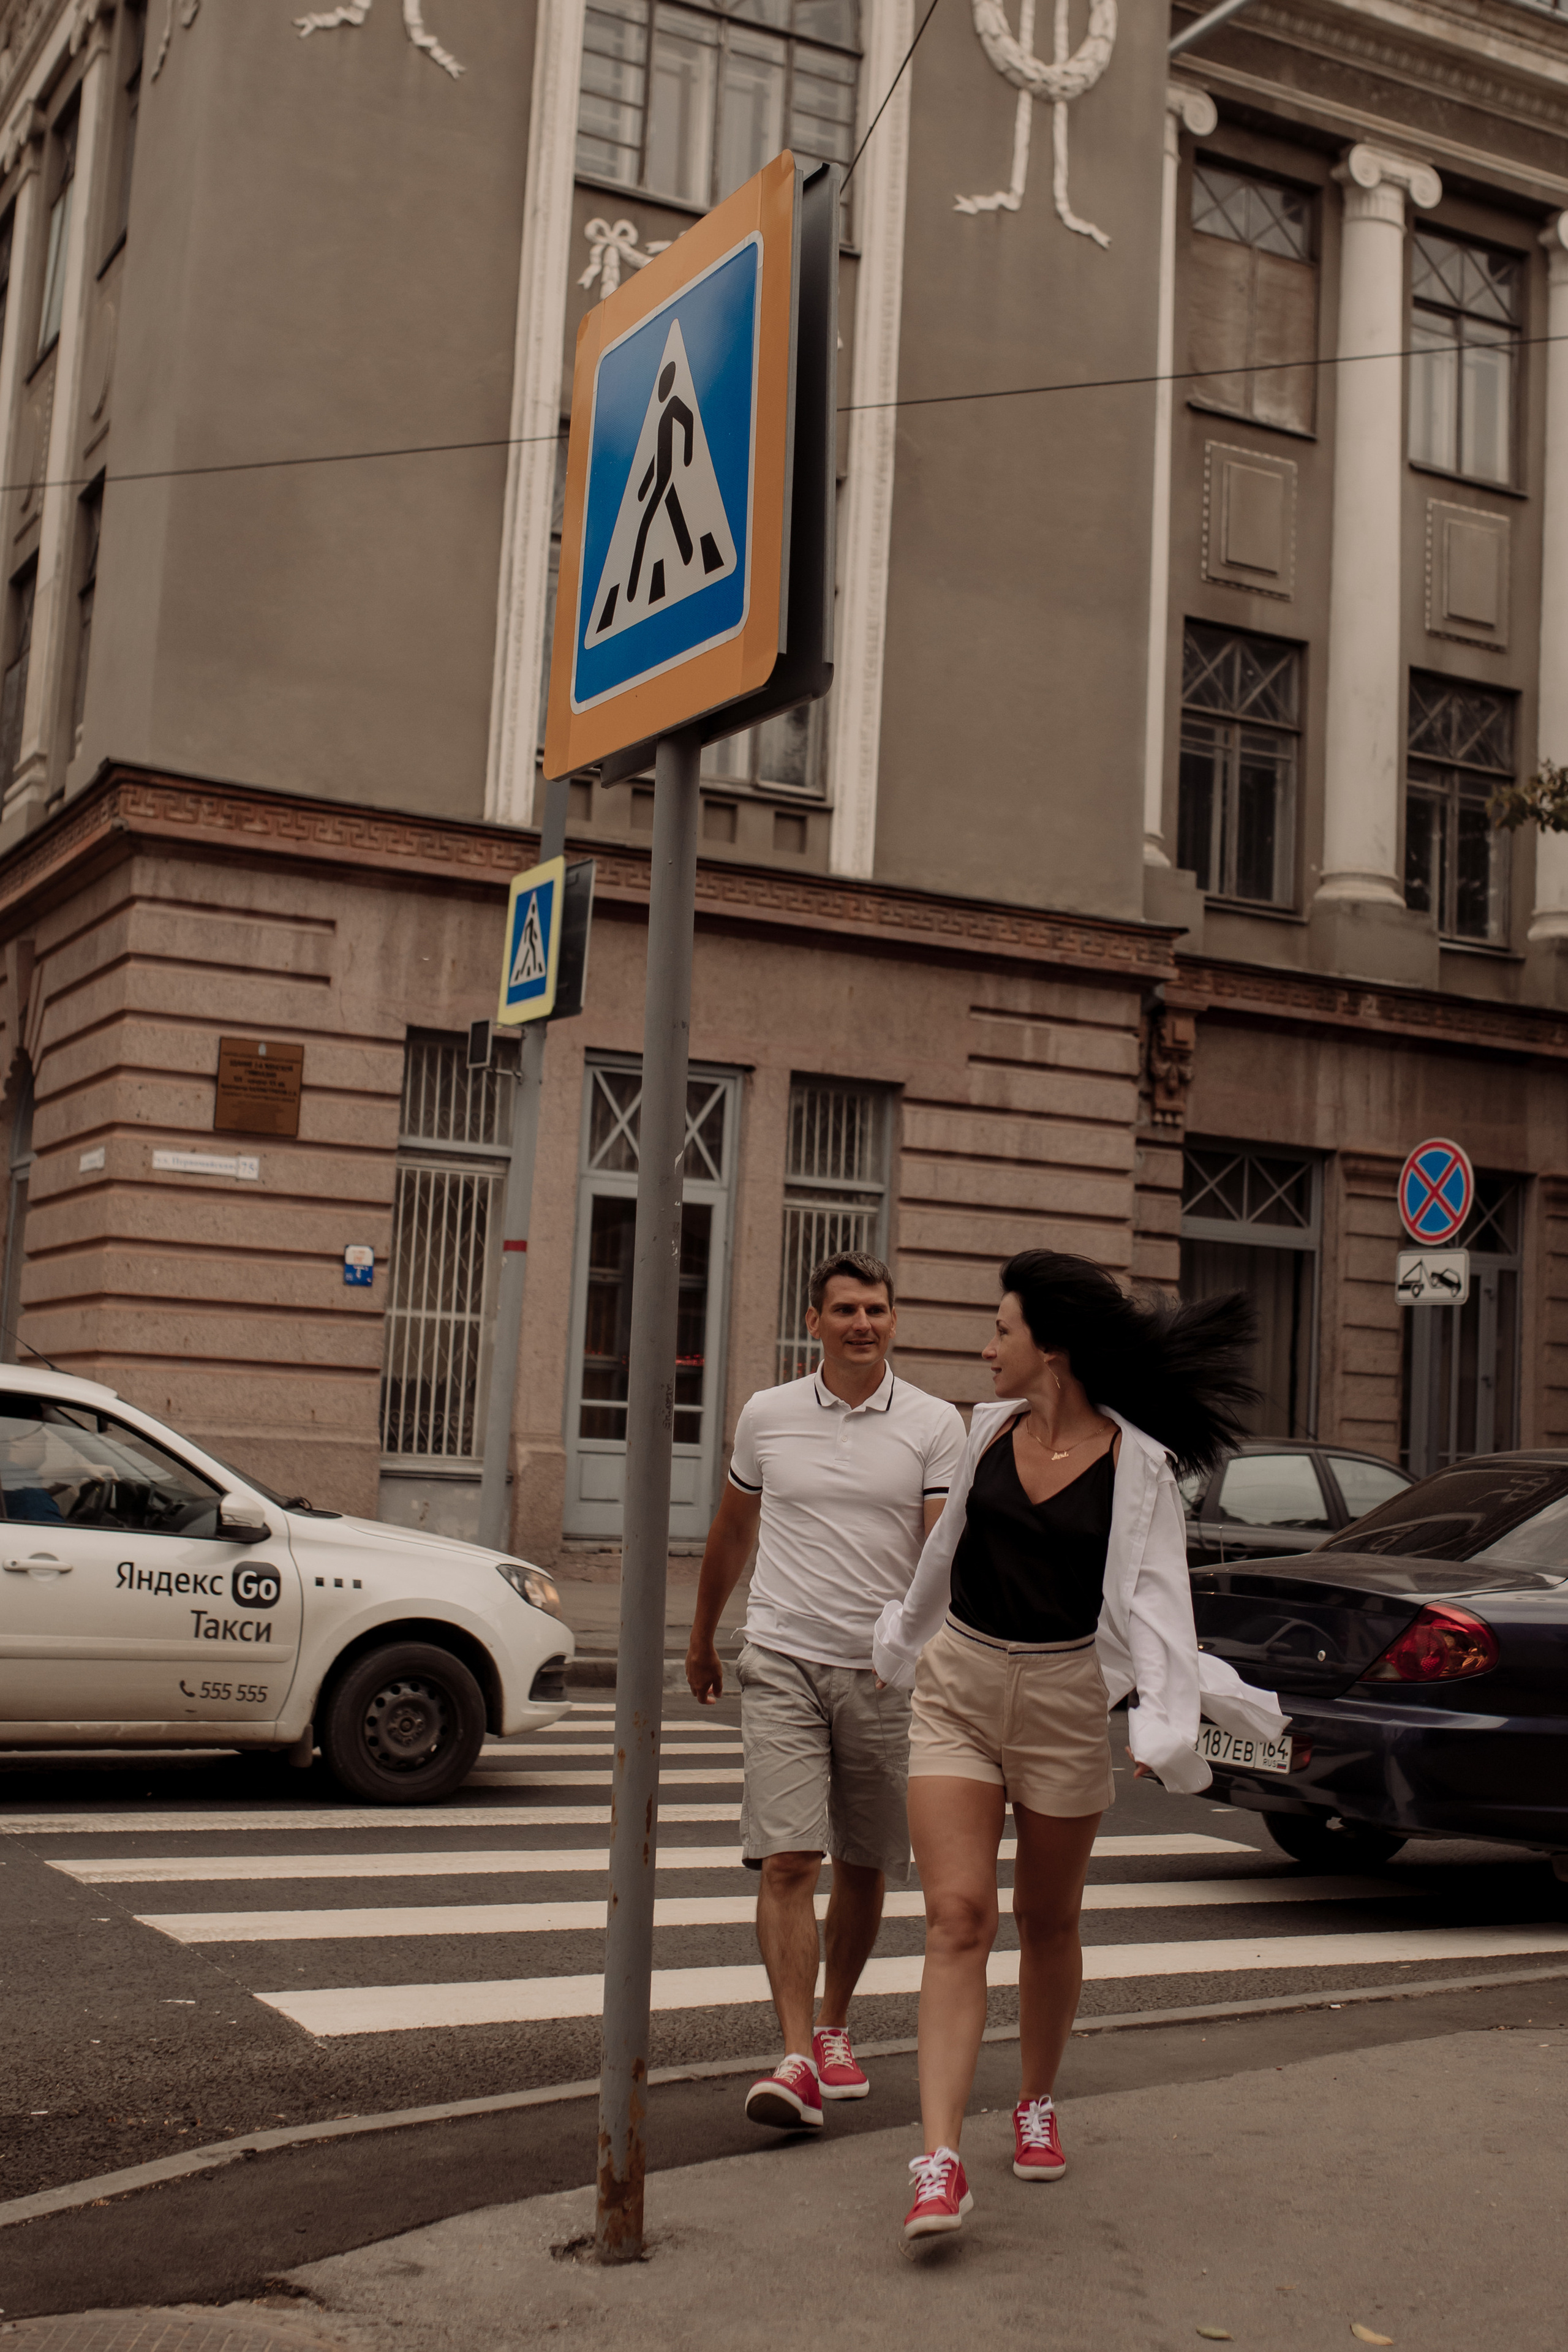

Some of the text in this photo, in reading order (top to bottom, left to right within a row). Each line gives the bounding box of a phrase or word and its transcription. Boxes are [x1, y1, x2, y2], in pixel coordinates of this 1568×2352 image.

[116, 1562, 278, 1600] Яндекс Go
[190, 1610, 272, 1643] Такси
[199, 1681, 268, 1703] 555 555
[1194, 1728, 1254, 1762] 187ЕВ
[1262, 1758, 1276, 1768] RUS
